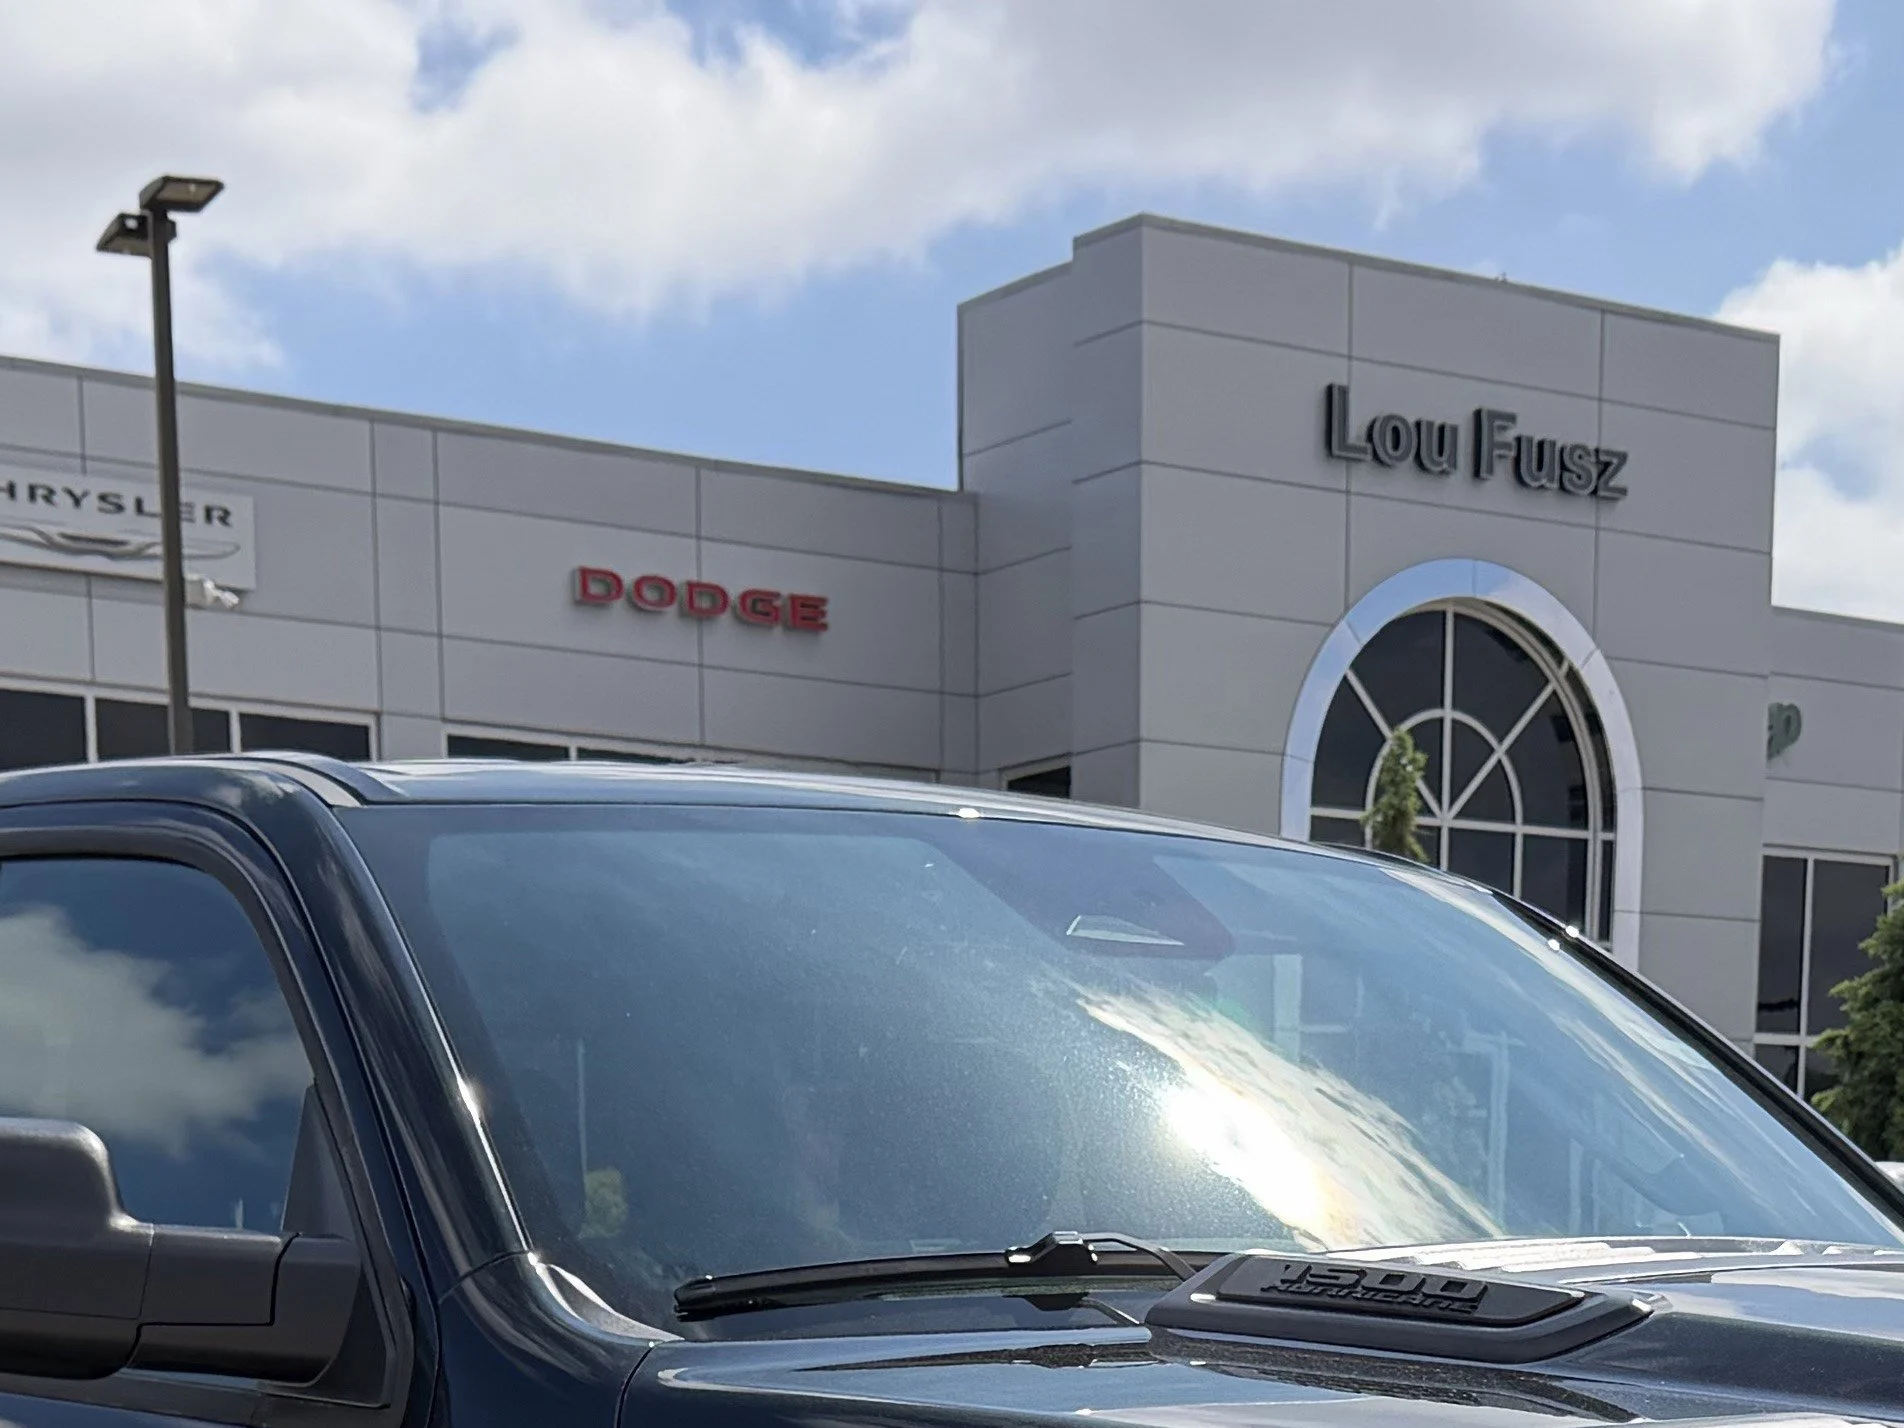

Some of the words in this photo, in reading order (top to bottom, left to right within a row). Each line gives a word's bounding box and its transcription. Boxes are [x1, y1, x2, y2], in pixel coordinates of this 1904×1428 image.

[1324, 383, 1459, 474] Lou
[1472, 407, 1628, 500] Fusz
[572, 565, 829, 632] DODGE
[1280, 1262, 1489, 1301] 1500
